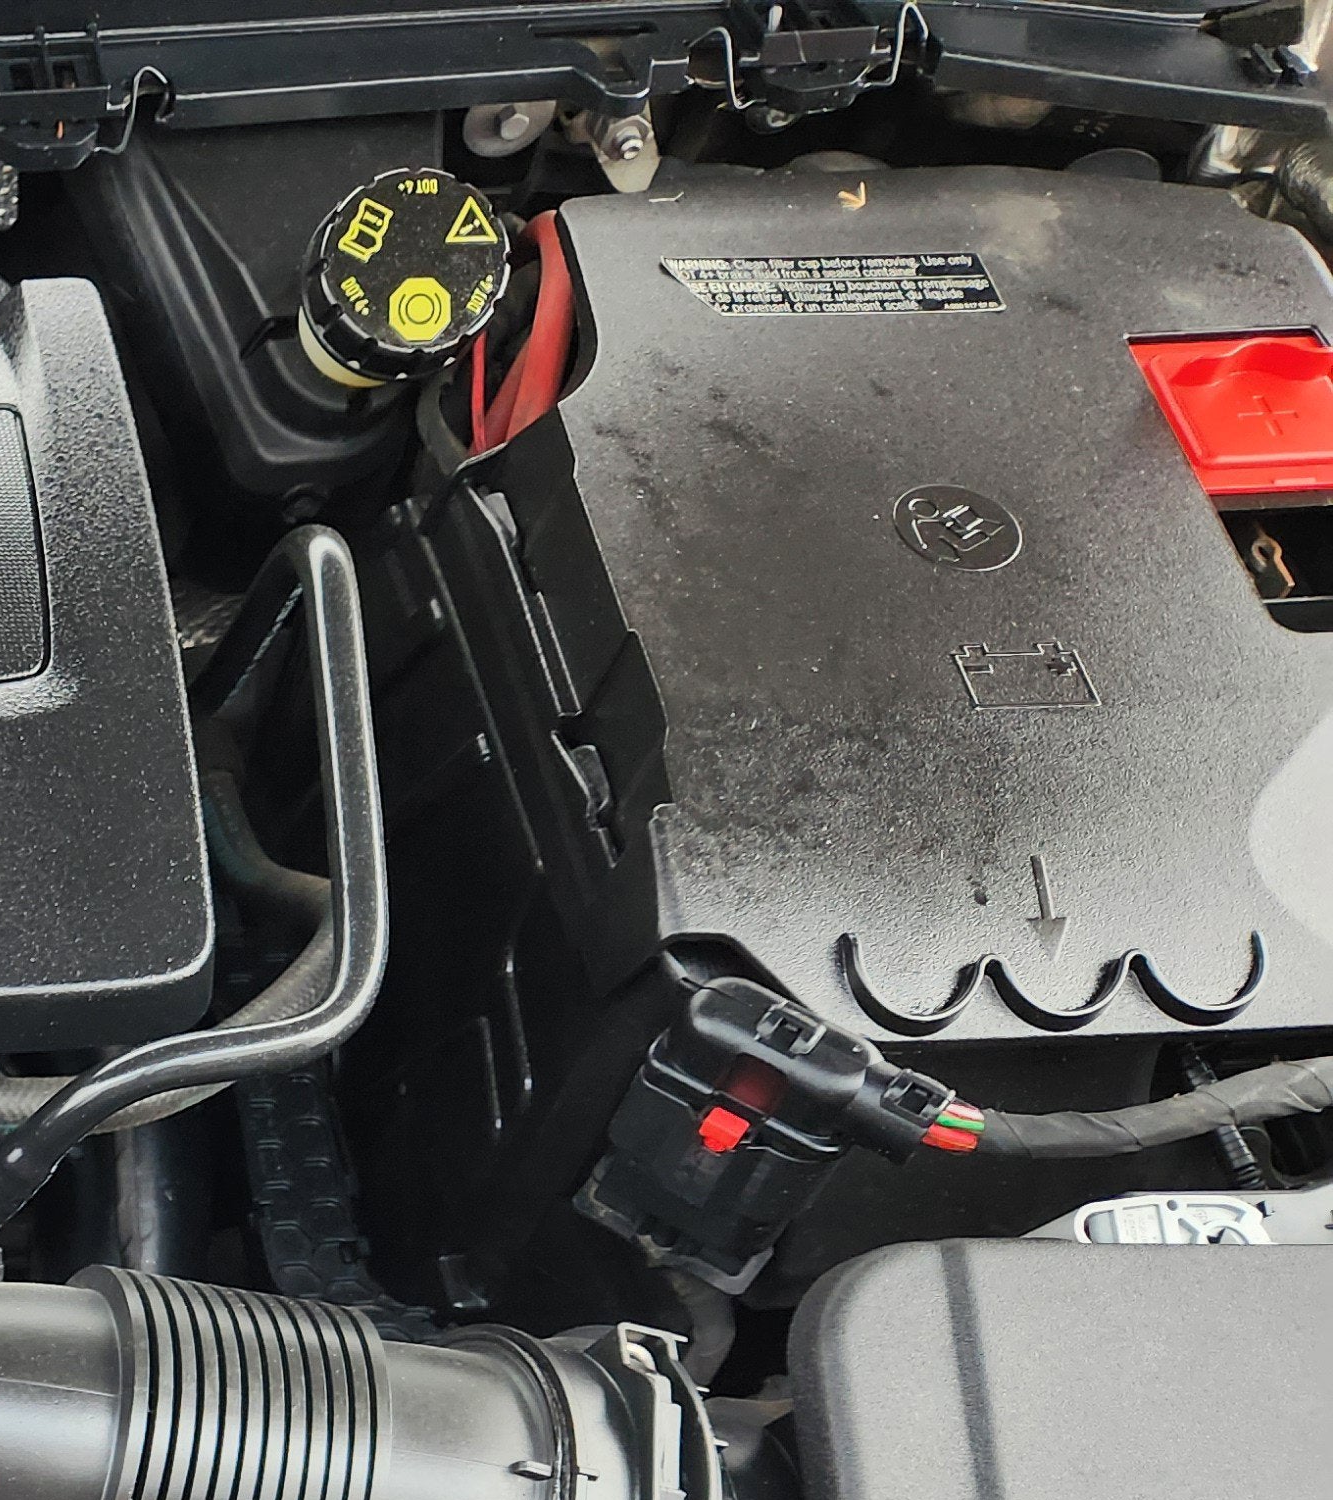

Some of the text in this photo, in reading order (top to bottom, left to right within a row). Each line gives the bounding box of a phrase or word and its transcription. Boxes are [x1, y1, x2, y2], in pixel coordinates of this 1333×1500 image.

[415, 178, 438, 195] DOT
[734, 259, 768, 271] Clean
[797, 260, 821, 272] cap
[821, 257, 860, 270] before
[921, 255, 945, 267] Use
[947, 255, 973, 268] only
[715, 269, 751, 280] brake
[752, 268, 780, 280] fluid
[782, 268, 810, 279] from
[811, 269, 820, 278] a
[708, 282, 728, 293] EN
[778, 281, 833, 294] Nettoyez
[834, 281, 846, 291] le
[901, 279, 917, 290] de
[715, 293, 731, 303] de
[733, 292, 745, 302] le
[788, 291, 833, 303] Utilisez
[834, 290, 904, 303] uniquement
[906, 290, 922, 300] du
[924, 288, 965, 301] liquide
[732, 302, 792, 314] provenant
[794, 301, 820, 313] d'un
[822, 300, 883, 312] contenant
